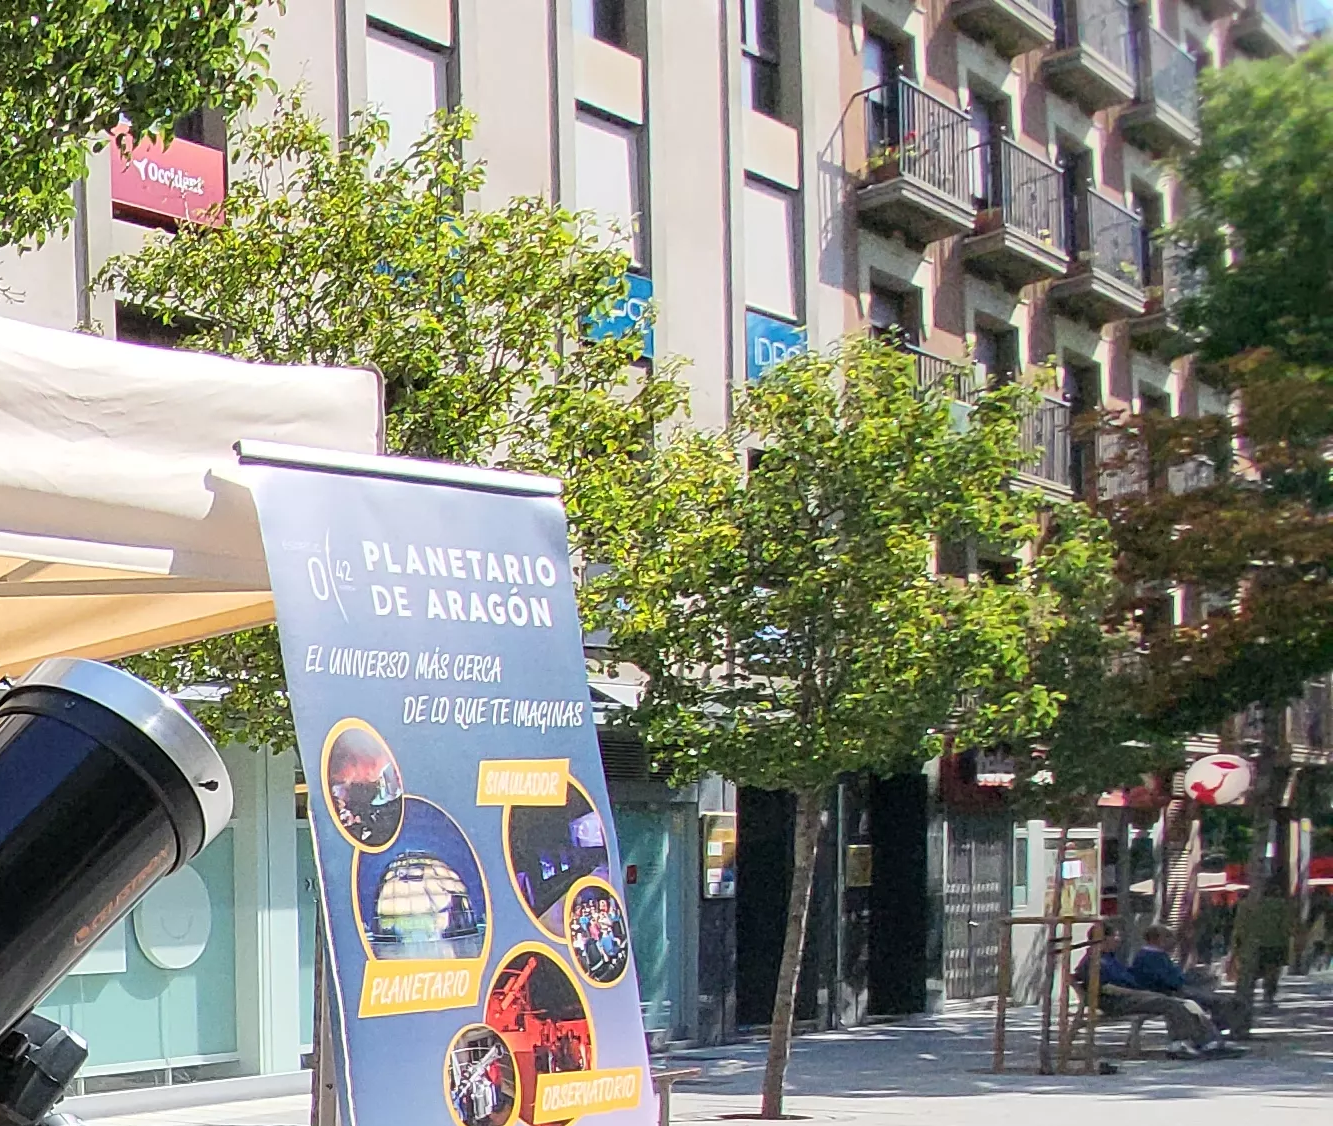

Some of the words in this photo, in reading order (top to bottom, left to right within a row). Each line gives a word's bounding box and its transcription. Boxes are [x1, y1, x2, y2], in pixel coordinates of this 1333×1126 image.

[361, 540, 557, 587] PLANETARIO
[371, 584, 412, 617] DE
[427, 586, 554, 628] ARAGÓN
[305, 645, 325, 674] EL
[328, 646, 410, 680] UNIVERSO
[415, 646, 449, 683] MÁS
[453, 653, 503, 684] CERCA
[403, 695, 429, 725] DE
[431, 697, 451, 728] LO
[453, 697, 490, 731] QUE
[491, 698, 511, 727] TE
[513, 698, 583, 734] IMAGINAS
[483, 769, 560, 798] SIMULADOR
[369, 968, 470, 1006] PLANETARIO
[541, 1072, 637, 1112] OBSERVATORIO
